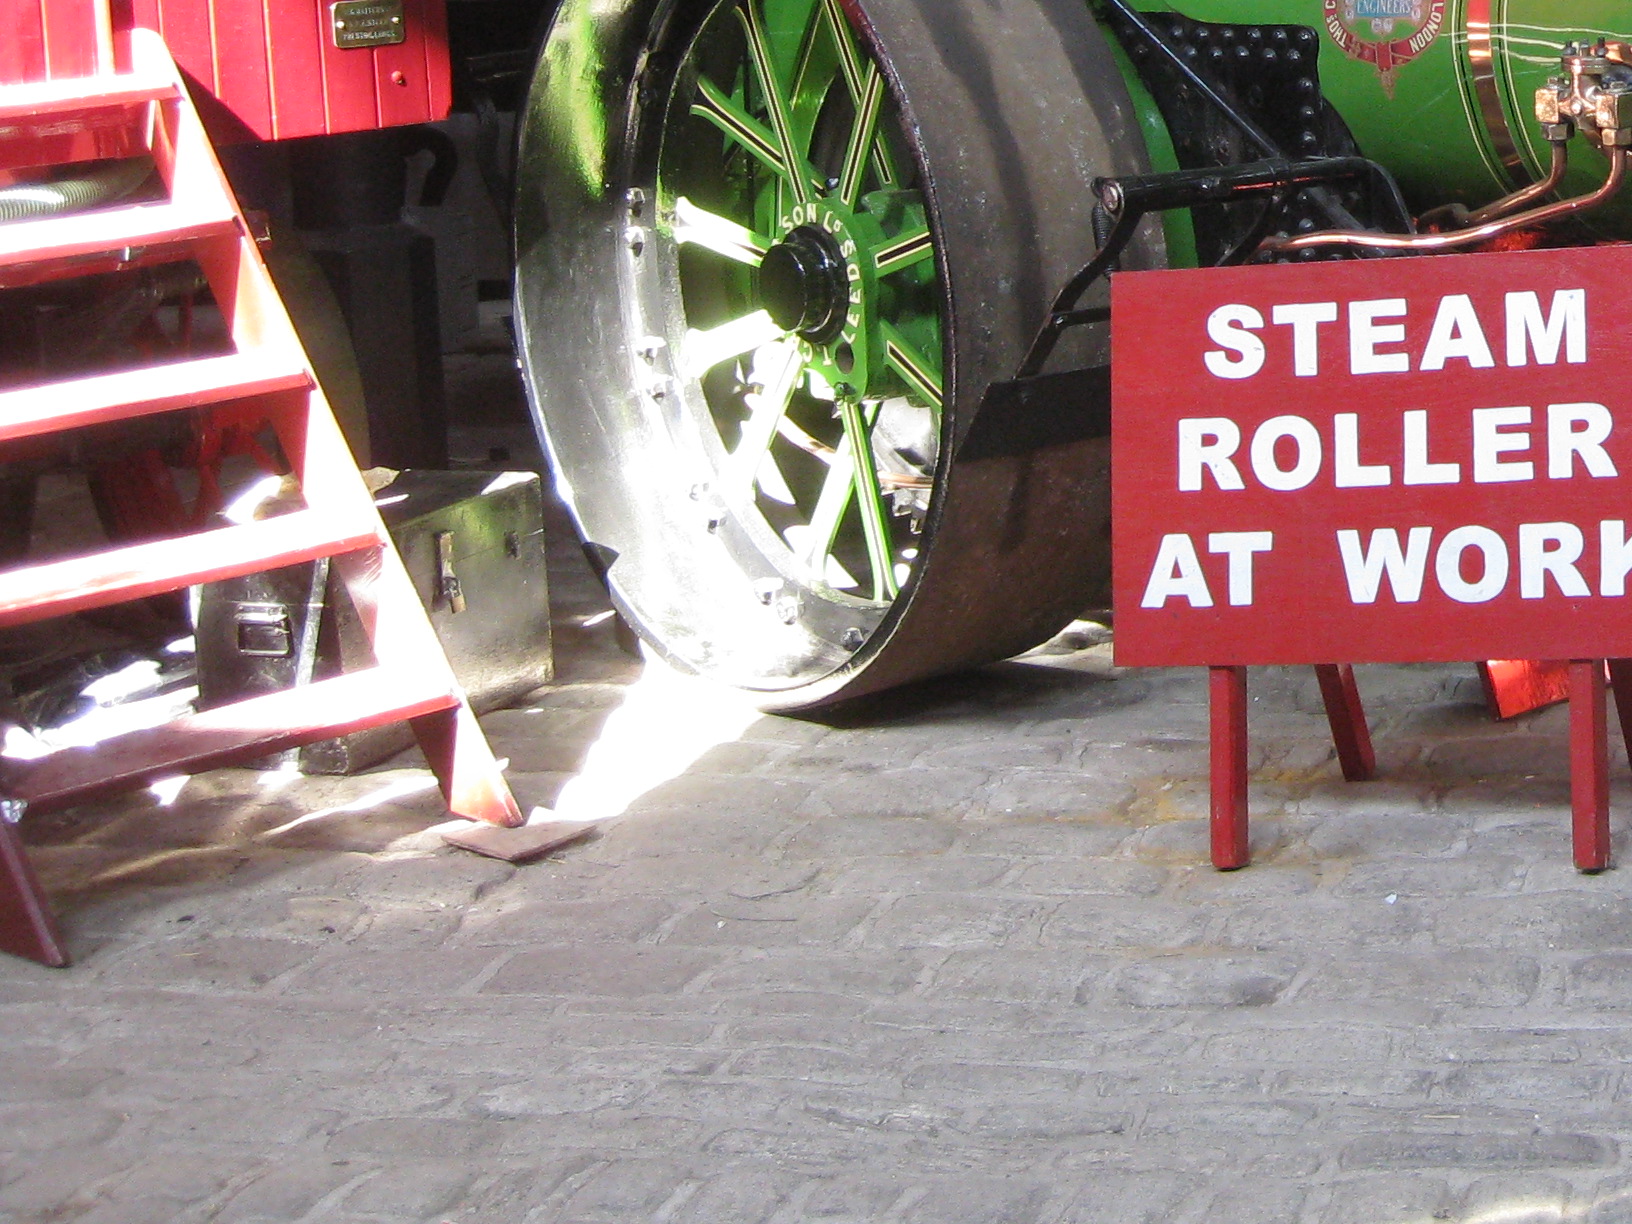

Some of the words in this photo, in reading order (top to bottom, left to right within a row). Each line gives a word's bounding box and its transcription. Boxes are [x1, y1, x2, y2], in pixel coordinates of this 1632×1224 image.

[1409, 2, 1445, 54] LONDON
[781, 203, 818, 235] SON
[841, 238, 863, 344] LEEDS
[1203, 288, 1588, 380] STEAM
[1177, 402, 1619, 492] ROLLER
[1140, 530, 1274, 609] AT
